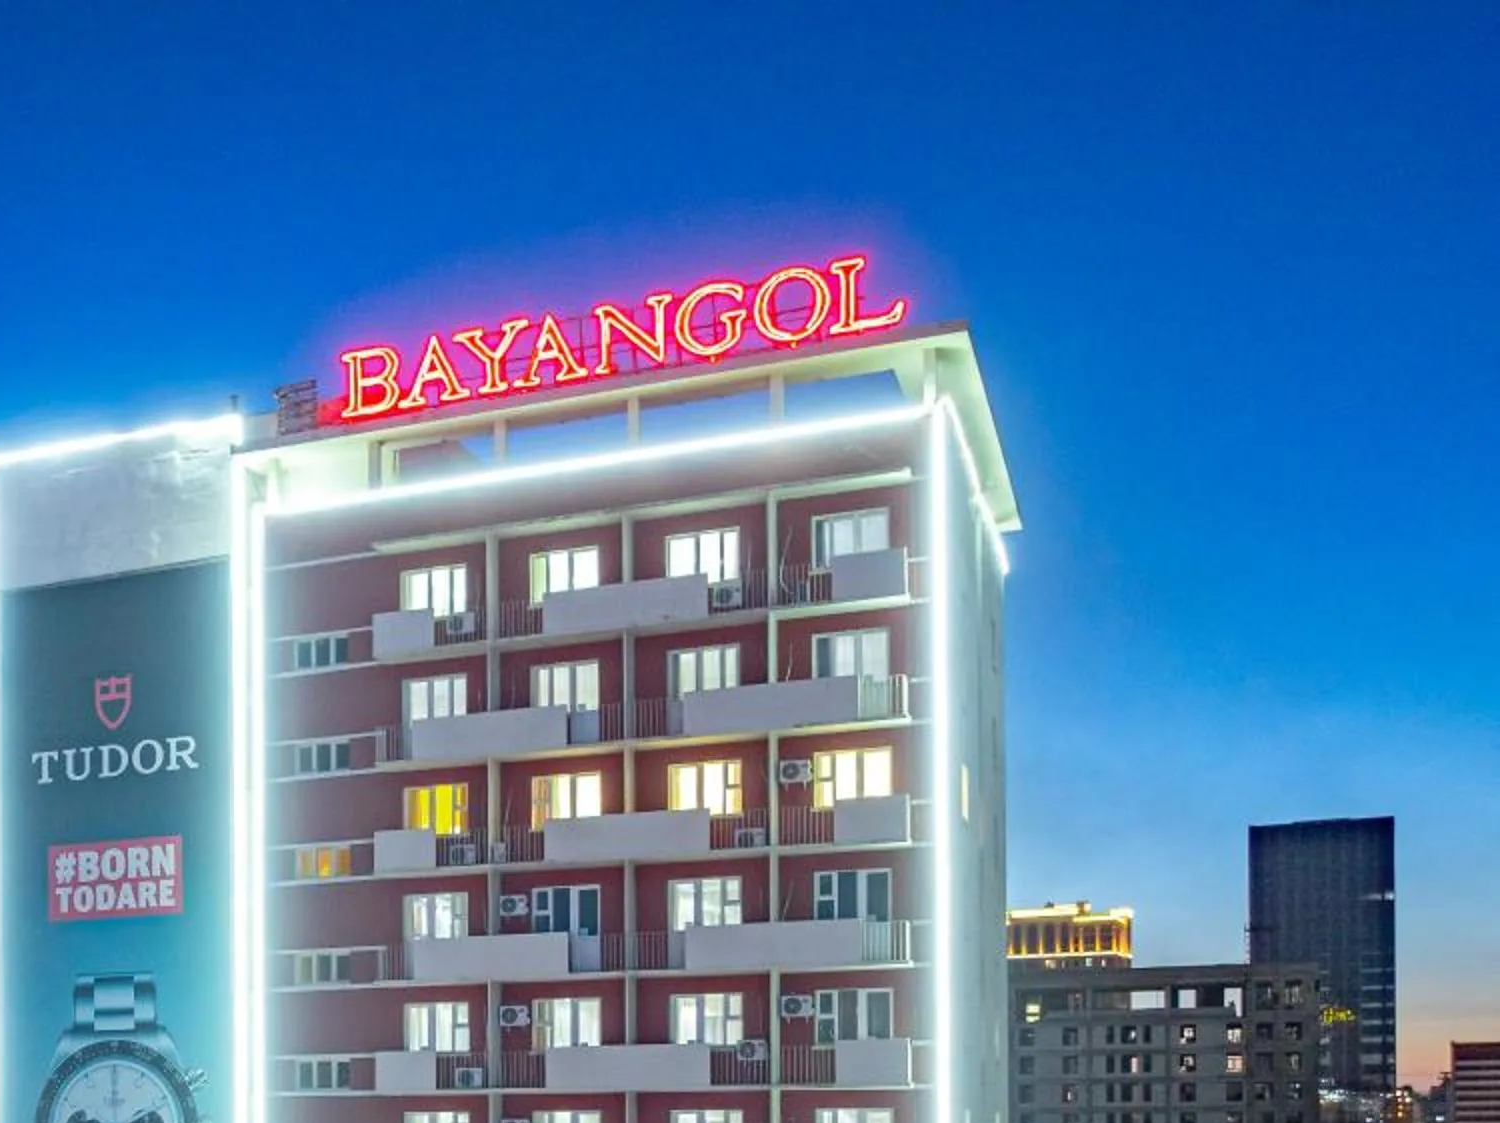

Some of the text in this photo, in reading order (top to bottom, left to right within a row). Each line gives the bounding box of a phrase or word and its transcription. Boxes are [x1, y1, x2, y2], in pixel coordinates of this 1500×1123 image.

[340, 255, 905, 419] BAYANGOL
[31, 735, 200, 785] TUDOR
[55, 843, 176, 885] #BORN
[55, 879, 177, 914] TODARE
